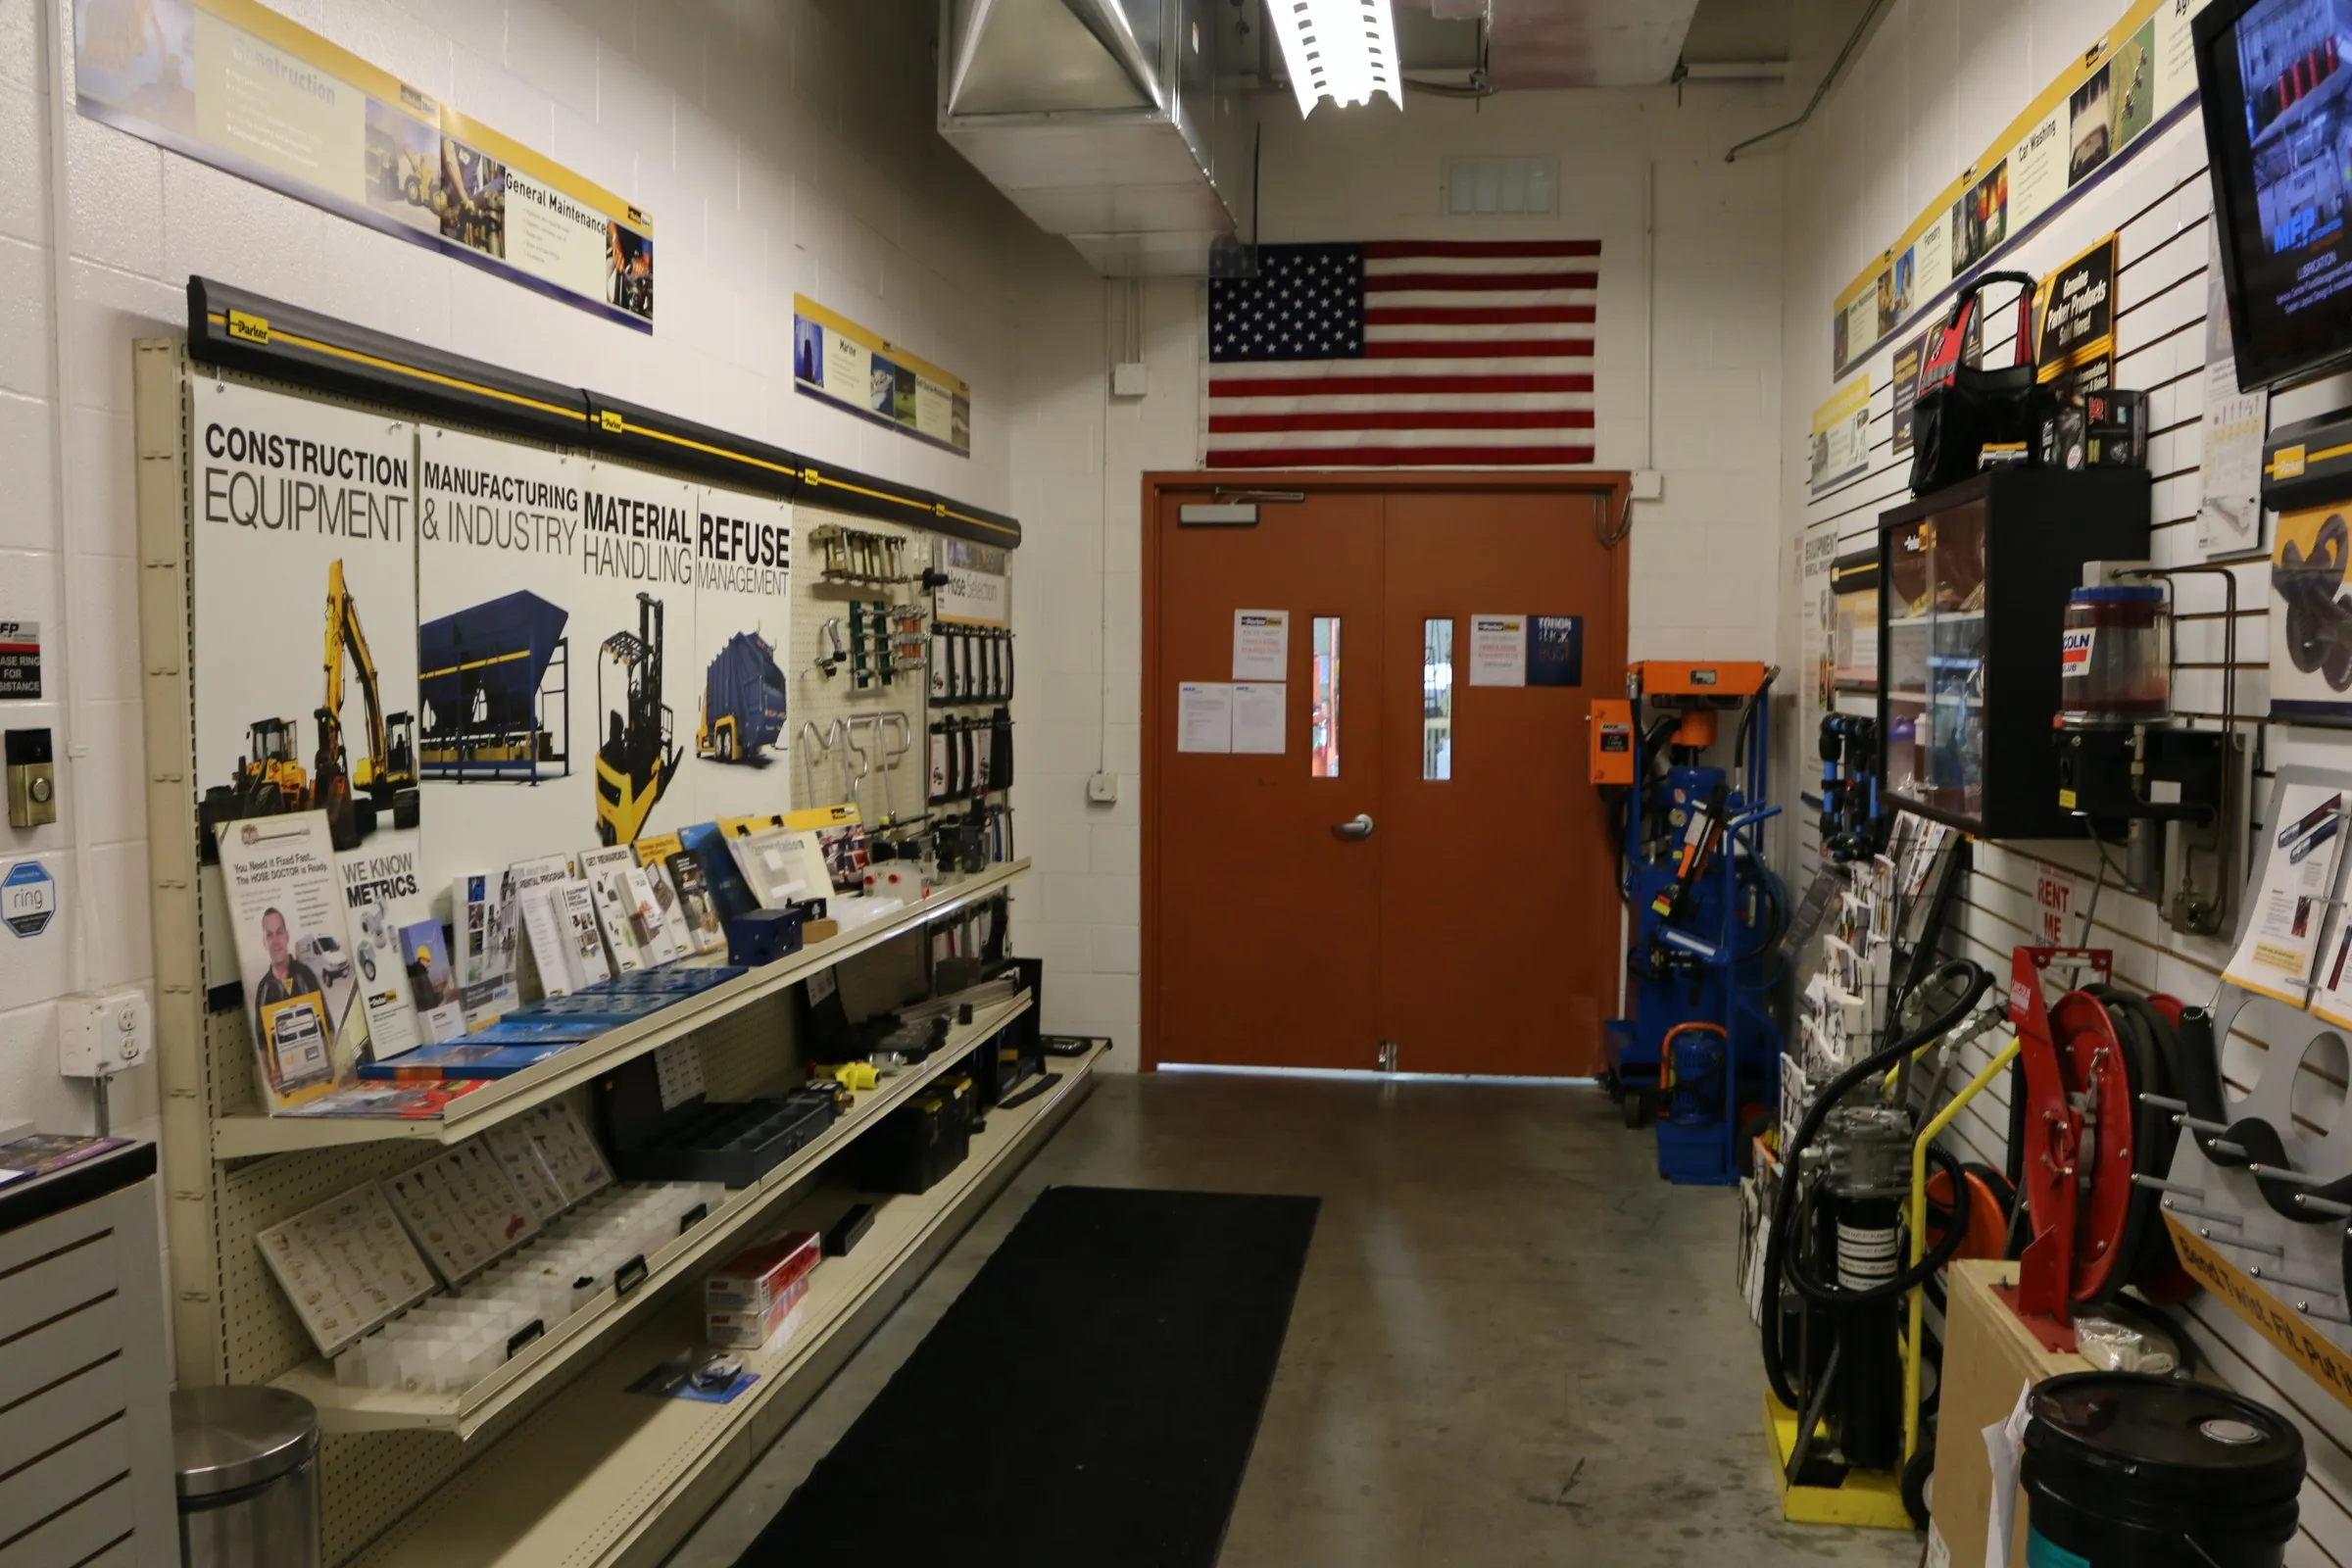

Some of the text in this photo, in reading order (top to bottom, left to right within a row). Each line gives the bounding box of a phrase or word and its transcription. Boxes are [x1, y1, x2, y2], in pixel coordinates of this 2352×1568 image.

[2019, 120, 2056, 163] Car Washing
[506, 172, 547, 207] General
[549, 193, 607, 235] Maintenance
[2274, 207, 2315, 253] MFP
[2063, 270, 2088, 299] Genuine
[2047, 279, 2106, 332] Parker Products
[237, 320, 267, 340] Parker
[840, 338, 857, 358] Marine
[205, 422, 408, 488] CONSTRUCTION
[424, 462, 578, 512] MANUFACTURING
[205, 467, 409, 542] EQUIPMENT
[584, 492, 692, 544] MATERIAL
[422, 498, 578, 556] & INDUSTRY
[699, 513, 790, 568] REFUSE
[584, 534, 692, 585] HANDLING
[698, 562, 789, 596] MANAGEMENT
[967, 573, 998, 602] Selection
[4, 668, 23, 679] FOR
[20, 656, 40, 666] RING
[234, 863, 248, 874] You
[249, 859, 269, 871] Need
[275, 856, 295, 866] Fixed
[236, 876, 249, 886] The
[250, 871, 270, 884] HOSE
[270, 866, 300, 880] DOCTOR
[342, 853, 412, 883] WE KNOW
[14, 888, 43, 910] ring
[346, 874, 419, 908] METRICS.
[2037, 877, 2070, 913] RENT
[2044, 911, 2062, 943] ME
